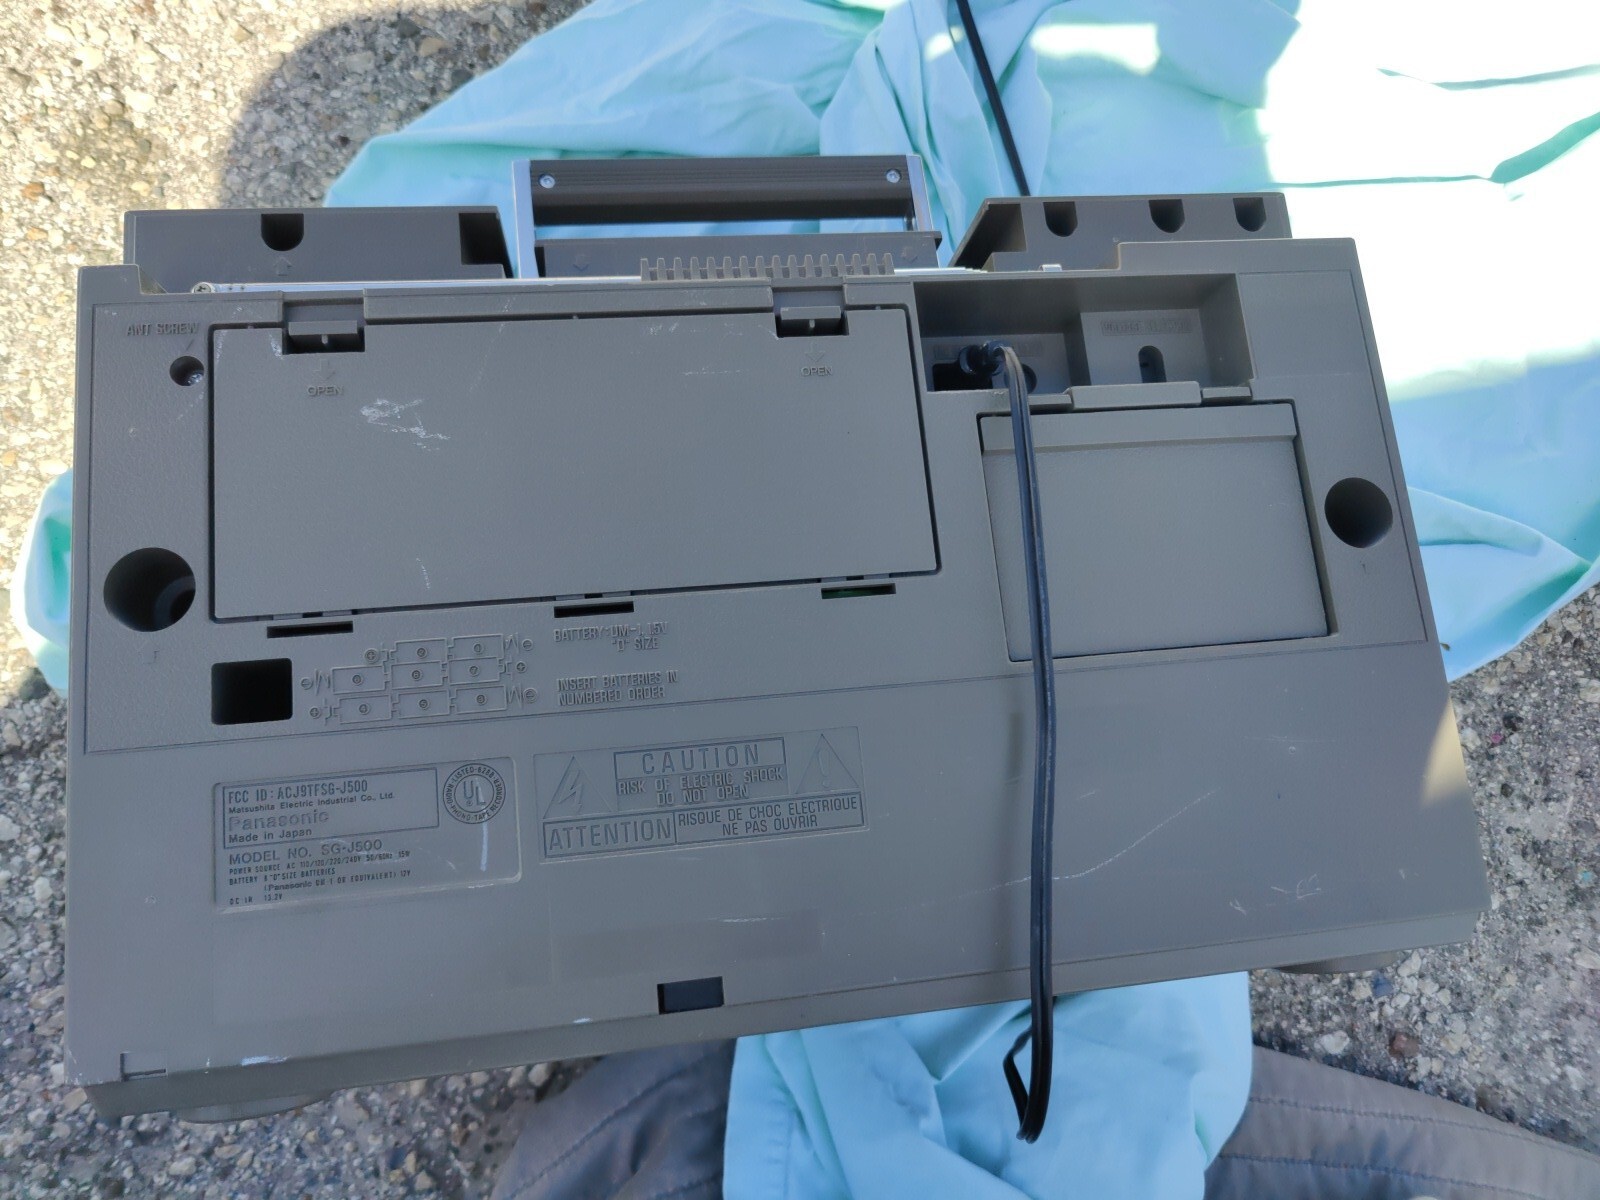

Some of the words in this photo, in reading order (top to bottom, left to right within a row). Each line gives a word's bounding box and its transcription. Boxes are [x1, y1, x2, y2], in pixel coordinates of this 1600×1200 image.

[127, 324, 150, 336] ANT
[156, 323, 199, 336] SCREW
[801, 366, 832, 376] OPEN
[308, 385, 344, 397] OPEN
[634, 636, 660, 650] SIZE
[557, 676, 598, 692] INSERT
[602, 671, 661, 688] BATTERIES
[666, 670, 678, 683] IN
[558, 690, 622, 706] NUMBERED
[628, 686, 666, 701] ORDER
[642, 743, 760, 774] CAUTION
[228, 790, 249, 804] FCC
[277, 780, 368, 800] ACJ9TFSG-J500
[618, 780, 646, 796] RISK
[654, 778, 671, 792] OF
[680, 772, 734, 789] ELECTRIC
[743, 767, 784, 784] SHOCK
[464, 780, 486, 806] UL
[657, 791, 674, 806] DO
[684, 788, 709, 803] NOT
[716, 785, 749, 800] OPEN
[228, 803, 275, 814] Matsushita
[280, 800, 314, 810] Electric
[318, 796, 356, 806] Industrial
[678, 810, 720, 827] RISQUE
[728, 808, 742, 822] DE
[750, 804, 782, 820] CHOC
[788, 796, 858, 816] ELECTRIQUE
[228, 810, 329, 832] Panasonic
[722, 822, 739, 836] NE
[746, 820, 768, 834] PAS
[774, 814, 818, 832] OUVRIR
[228, 834, 258, 844] Made
[264, 832, 274, 840] in
[279, 828, 312, 841] Japan
[550, 818, 672, 850] ATTENTION
[228, 850, 280, 865] MODEL
[288, 846, 312, 859] NO.
[321, 839, 383, 856] SG-J500
[229, 867, 252, 876] POWER
[256, 863, 281, 873] SOURCE
[286, 861, 296, 869] AC
[229, 876, 258, 886] BATTERY
[300, 868, 336, 878] BATTERIES
